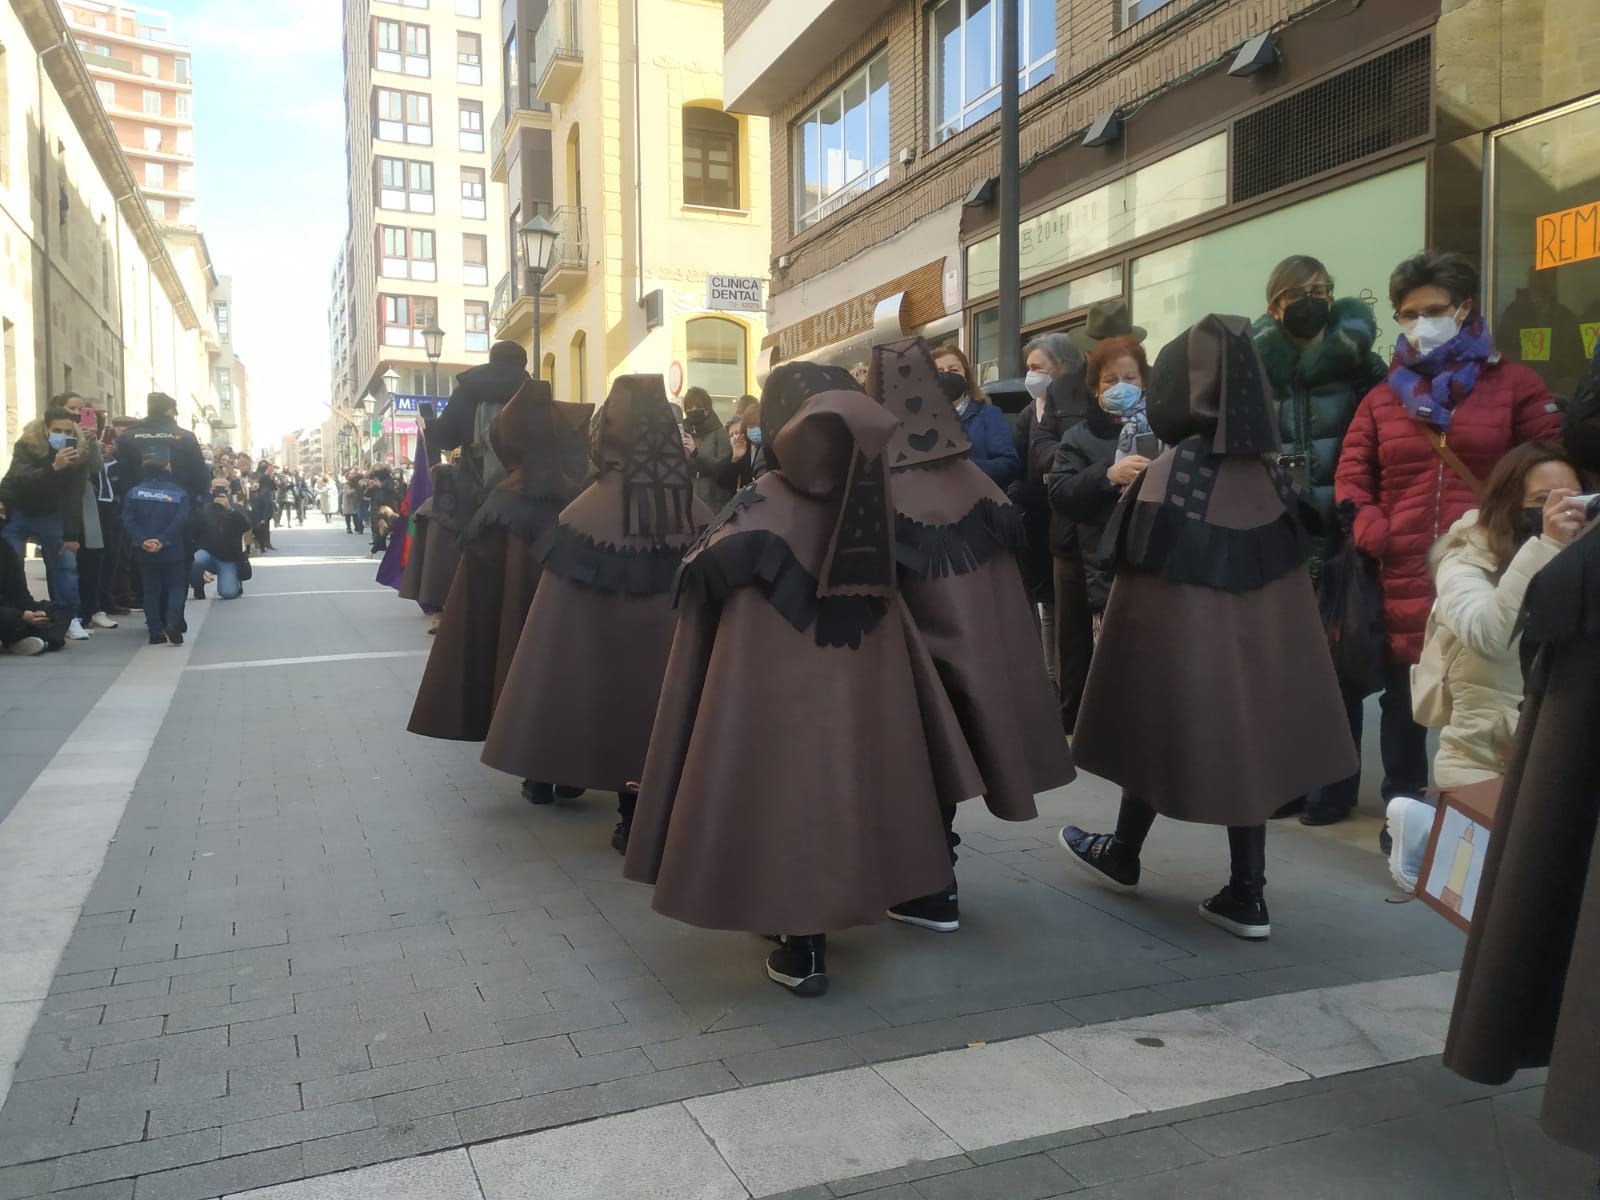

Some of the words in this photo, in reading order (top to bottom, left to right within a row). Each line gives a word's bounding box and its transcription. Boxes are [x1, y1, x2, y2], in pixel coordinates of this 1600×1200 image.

[1541, 204, 1600, 266] REM
[712, 277, 759, 290] CLINICA
[712, 289, 759, 302] DENTAL
[779, 322, 808, 358] MIL
[813, 294, 877, 347] HOJAS
